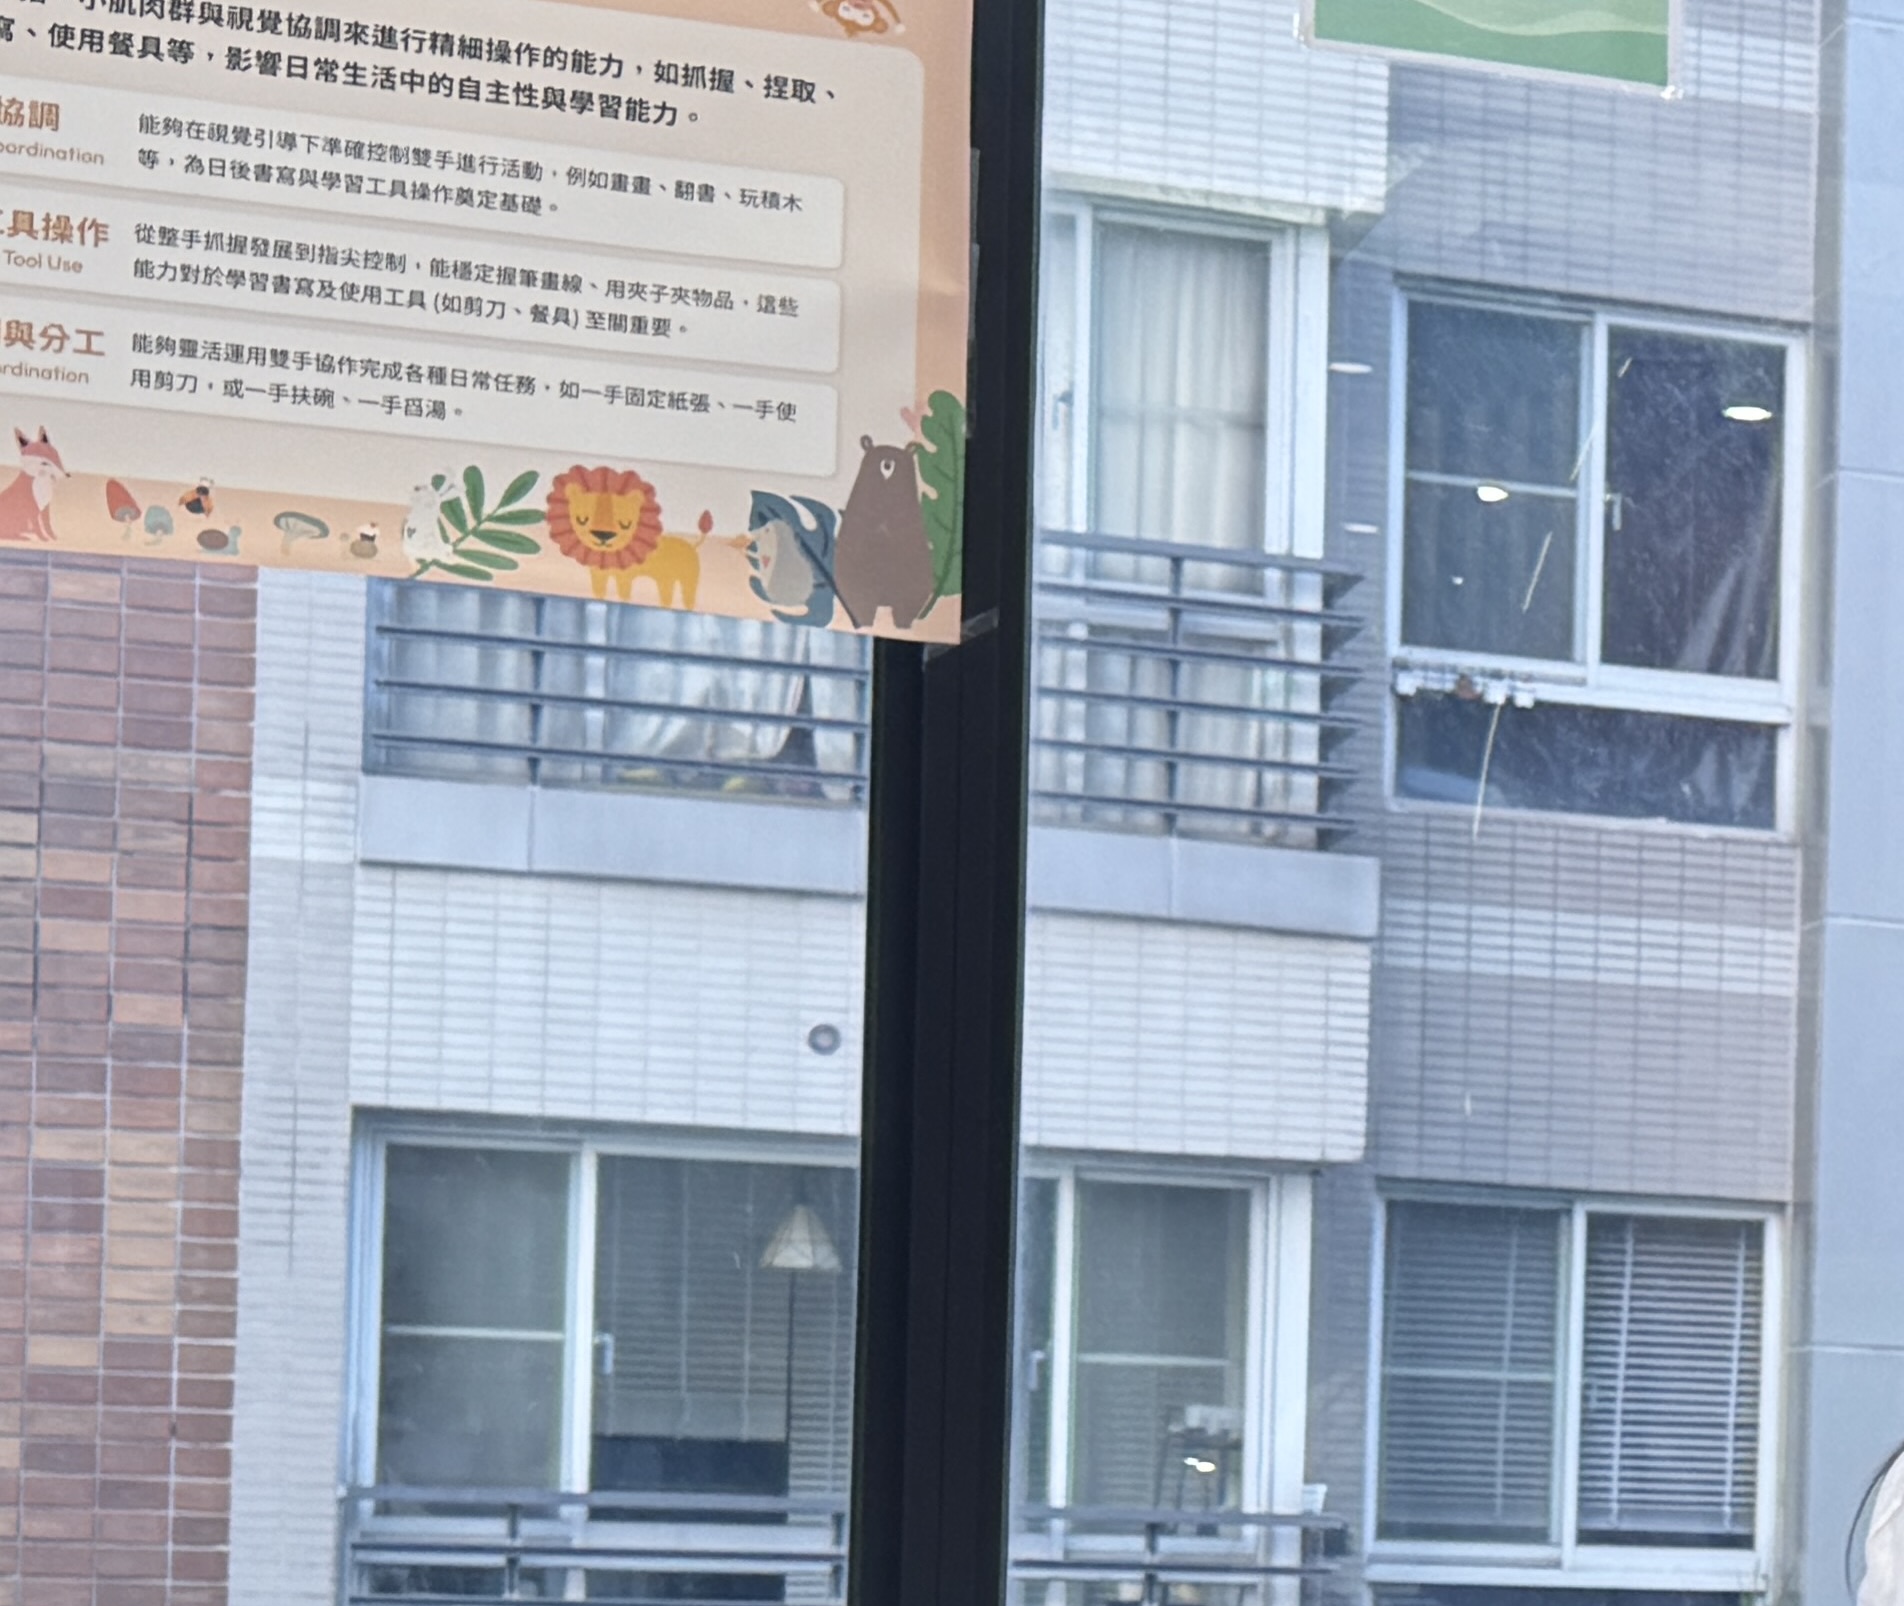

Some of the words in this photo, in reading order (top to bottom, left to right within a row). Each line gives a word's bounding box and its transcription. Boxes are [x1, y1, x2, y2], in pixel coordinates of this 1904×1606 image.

[0, 209, 110, 248] 具操作
[3, 249, 42, 269] Tool
[47, 254, 83, 273] Use
[0, 361, 89, 383] rdination
